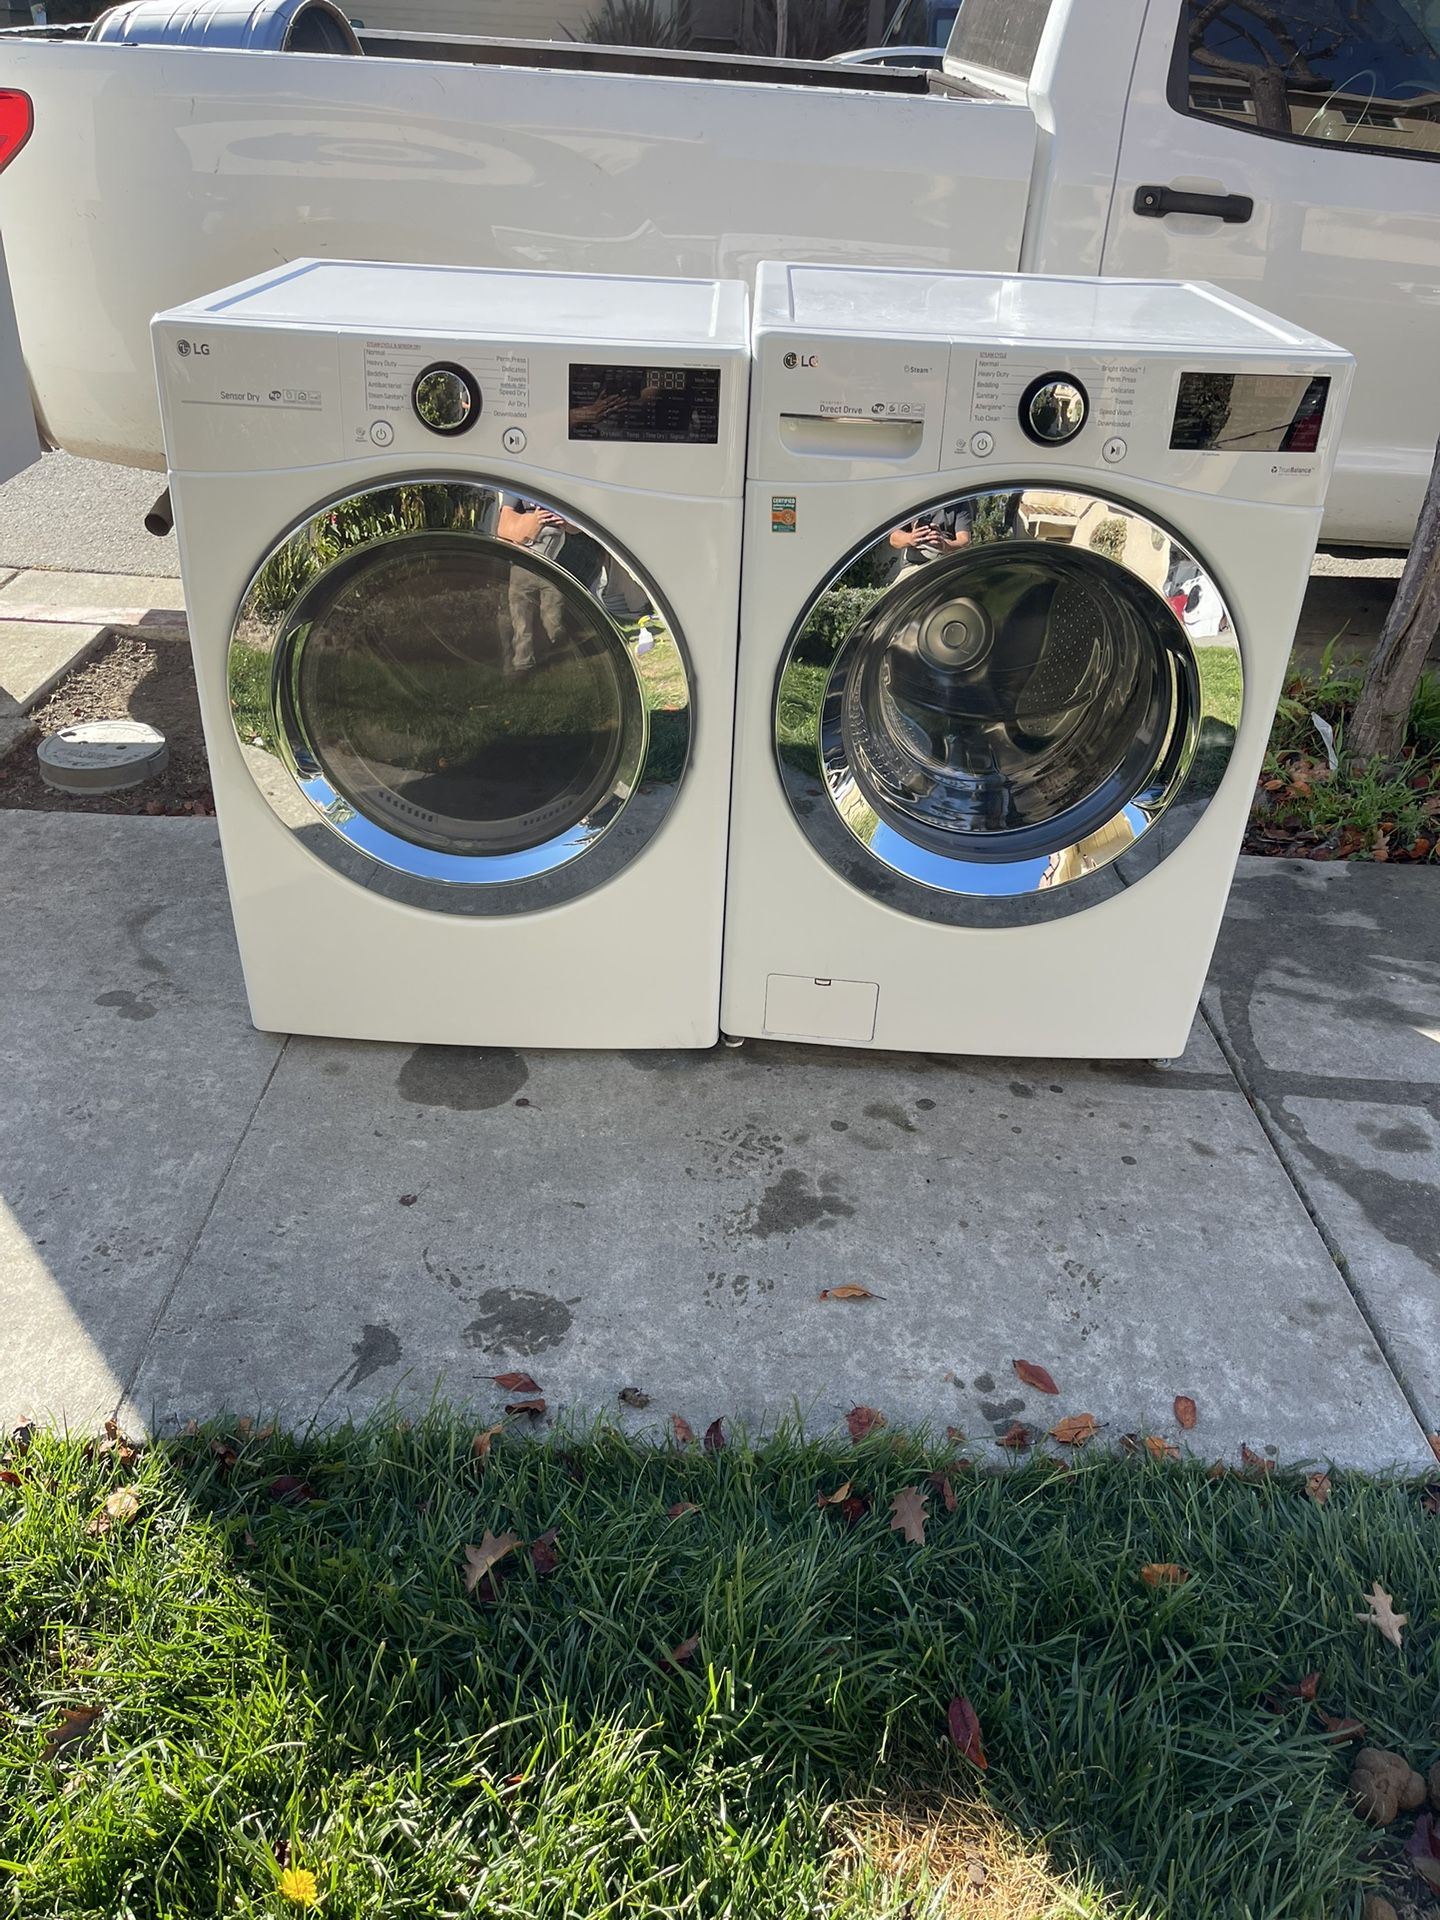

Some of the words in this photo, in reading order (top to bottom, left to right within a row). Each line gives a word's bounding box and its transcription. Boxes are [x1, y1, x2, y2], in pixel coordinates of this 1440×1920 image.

[193, 343, 210, 355] LG
[801, 356, 819, 368] LG
[367, 370, 388, 378] Bedding
[1111, 386, 1135, 394] Delicates
[220, 391, 246, 400] Sensor
[247, 392, 260, 402] Dry
[976, 392, 998, 400] Sanitary
[820, 405, 842, 414] Direct
[843, 406, 862, 414] Drive
